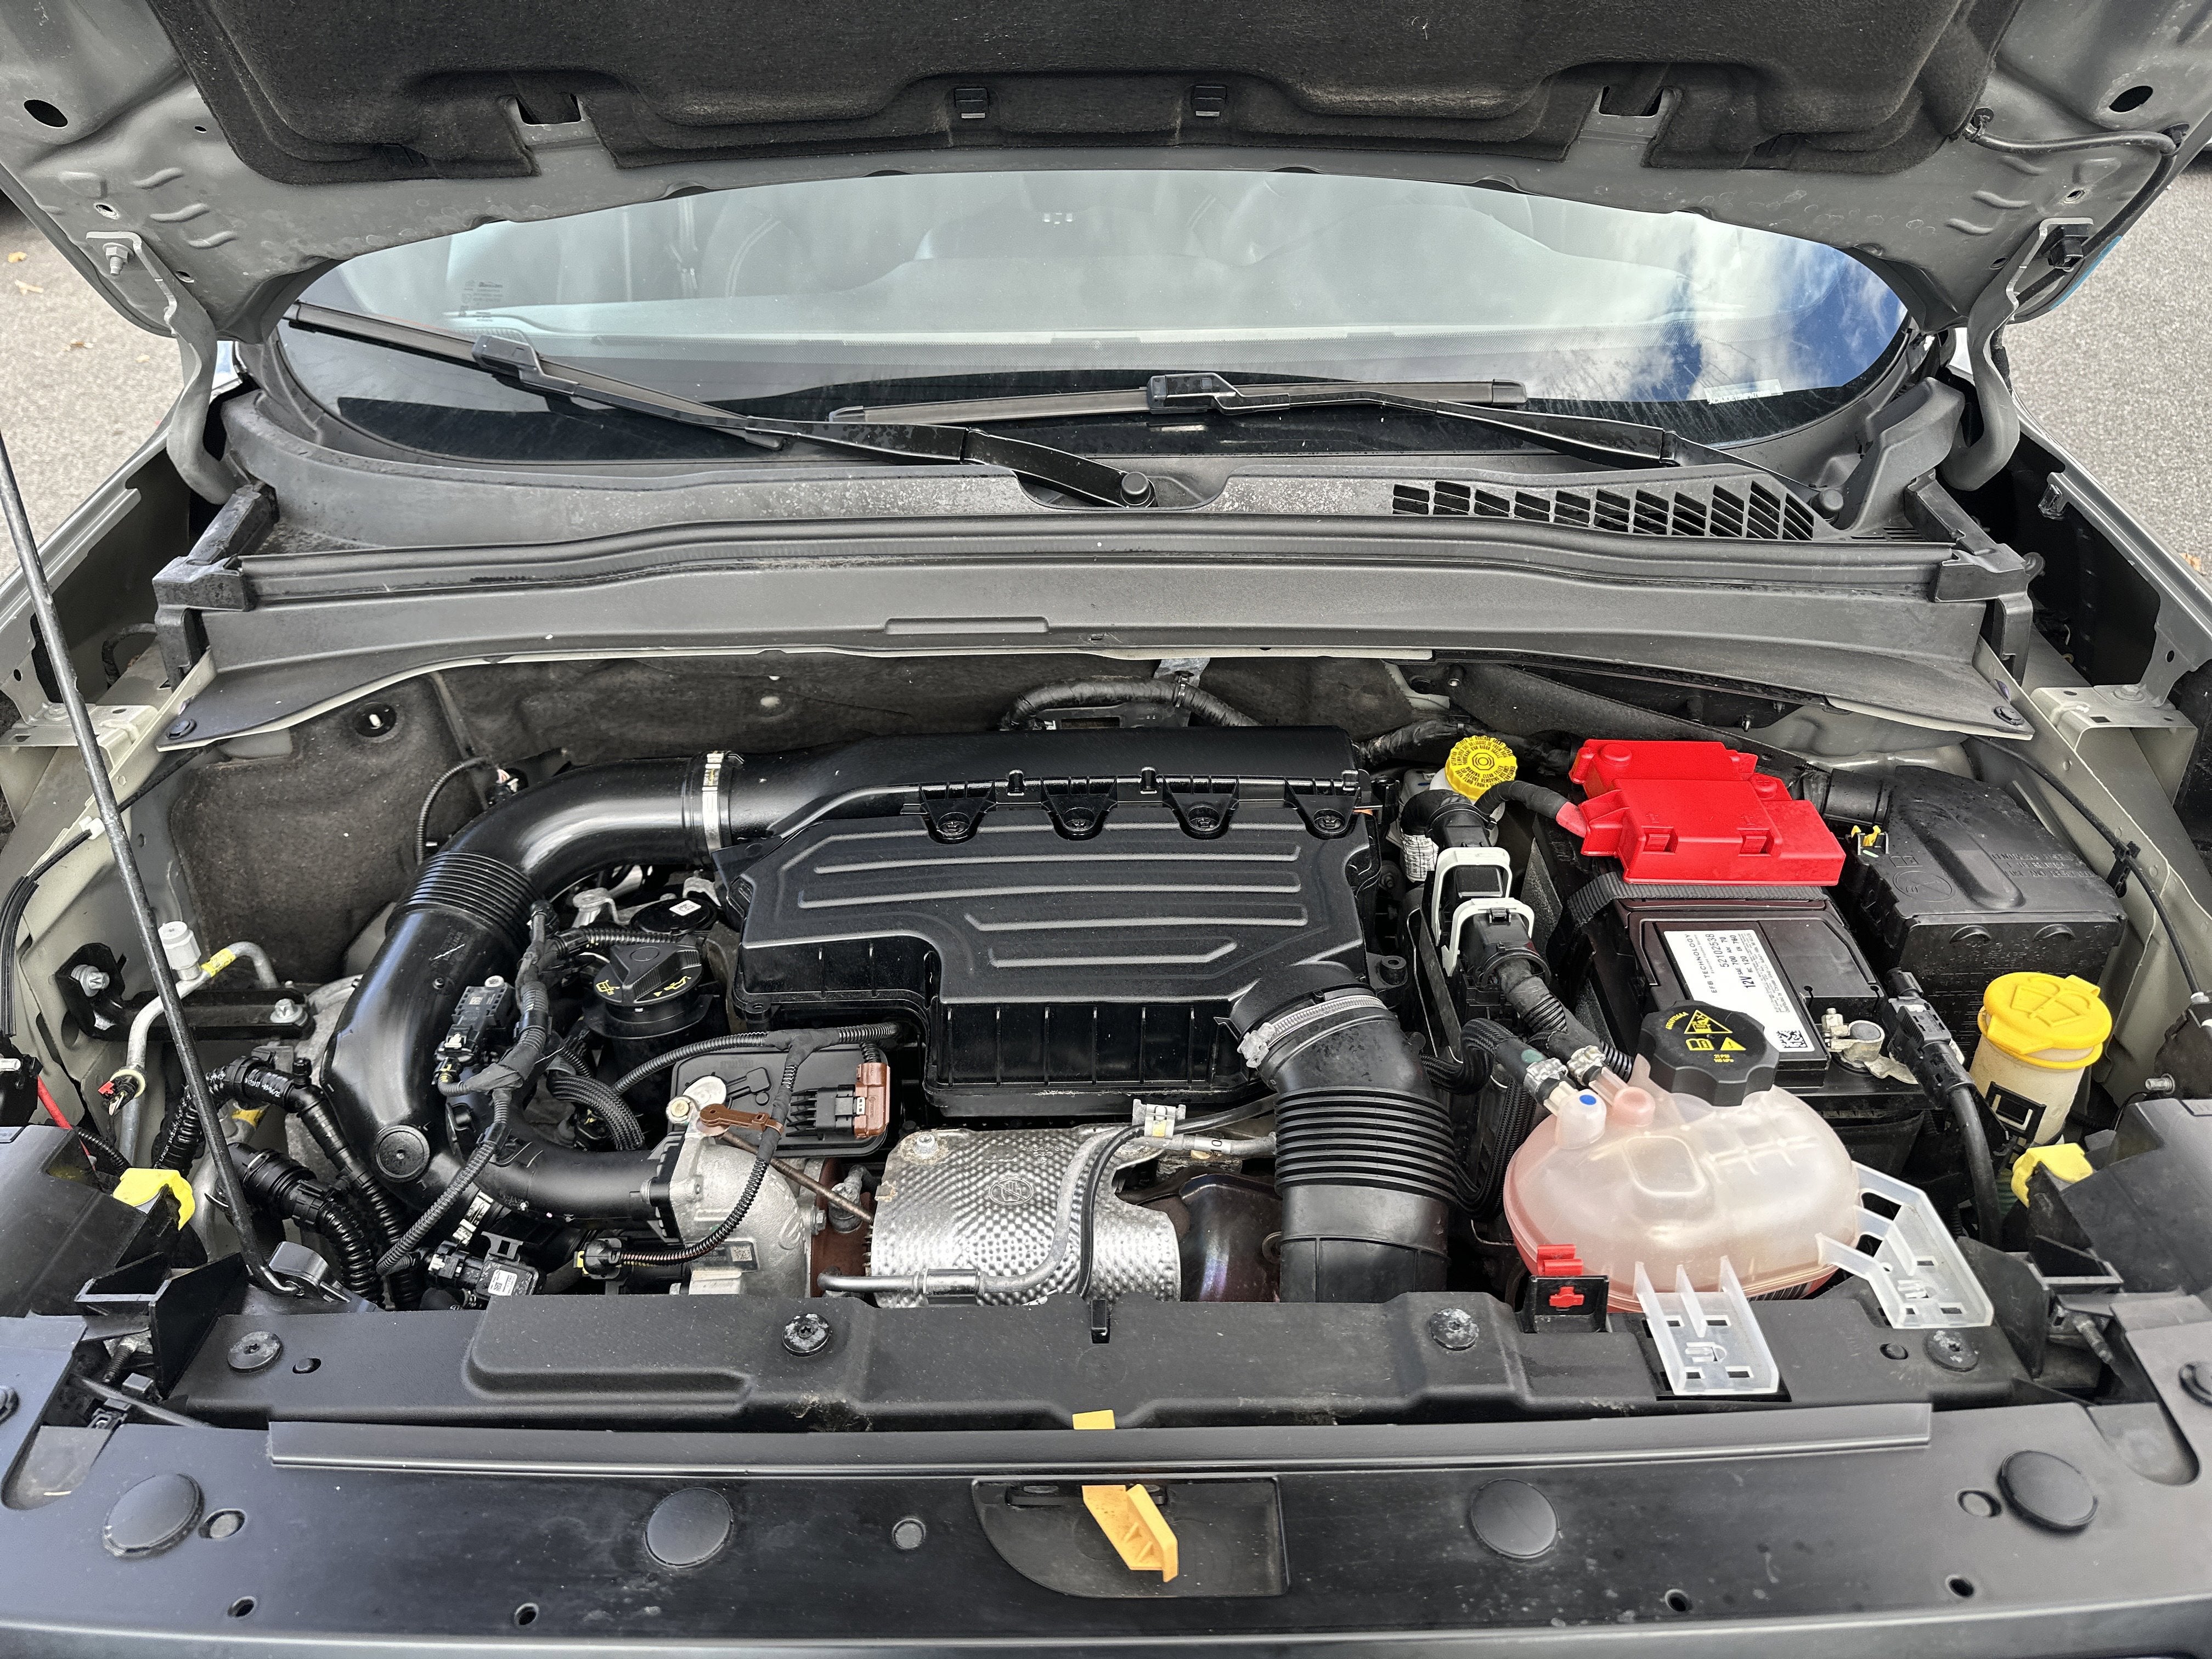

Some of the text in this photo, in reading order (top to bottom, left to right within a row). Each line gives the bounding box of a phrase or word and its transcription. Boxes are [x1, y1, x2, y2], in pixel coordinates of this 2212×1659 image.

[1730, 935, 1740, 944] 760
[1705, 934, 1729, 968] 52102538
[1684, 934, 1717, 993] EFB TECHNOLOGY
[1730, 956, 1739, 966] 700
[1740, 956, 1750, 966] 120
[1740, 975, 1756, 989] 12V
